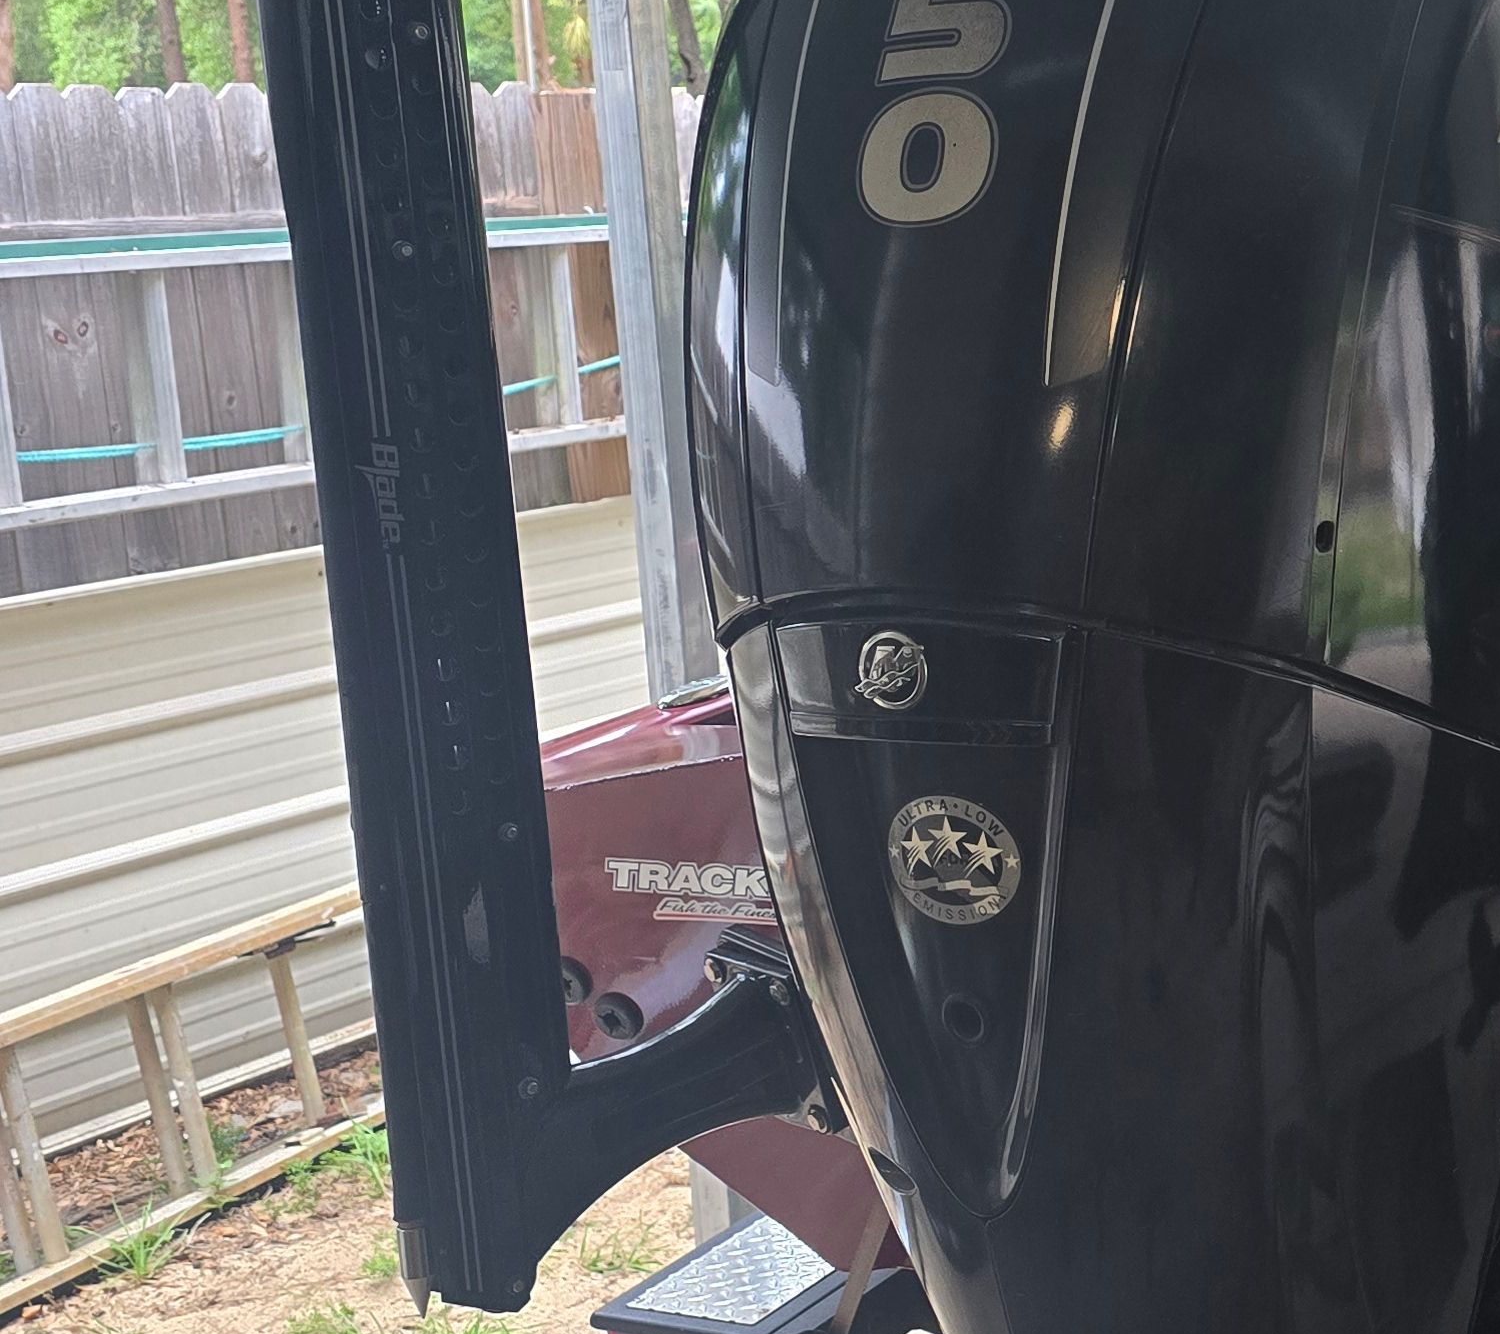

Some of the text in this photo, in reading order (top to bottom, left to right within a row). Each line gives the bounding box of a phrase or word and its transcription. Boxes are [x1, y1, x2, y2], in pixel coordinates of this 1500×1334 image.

[354, 442, 405, 544] Blade
[964, 804, 1005, 837] LOW
[606, 857, 771, 901] TRACK
[660, 899, 697, 913] Fish
[701, 903, 729, 914] the
